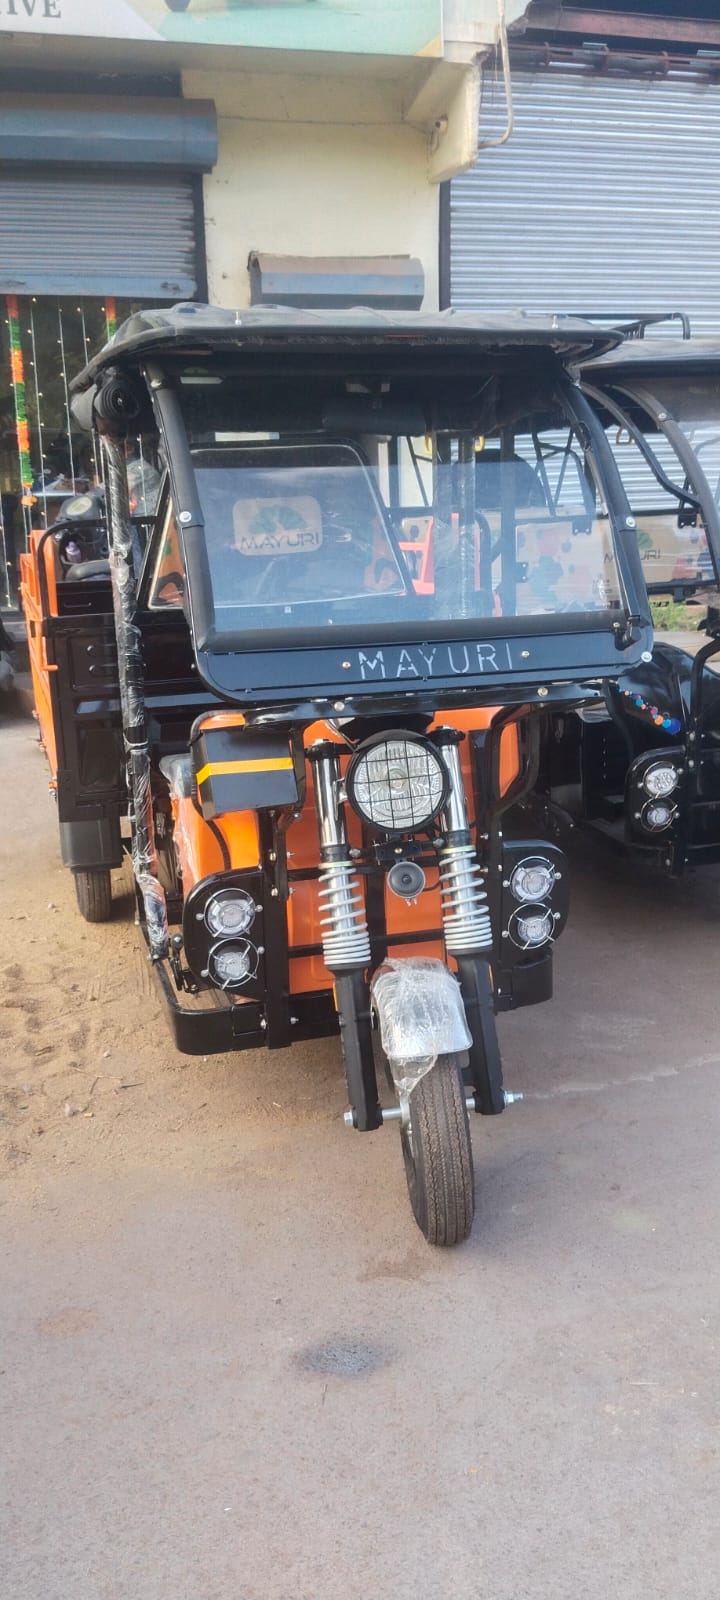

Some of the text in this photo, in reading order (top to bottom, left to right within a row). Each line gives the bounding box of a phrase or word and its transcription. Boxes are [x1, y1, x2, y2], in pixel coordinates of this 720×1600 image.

[0, 0, 61, 18] IVE
[240, 532, 320, 549] MAYURI
[357, 642, 513, 680] MAYURI
